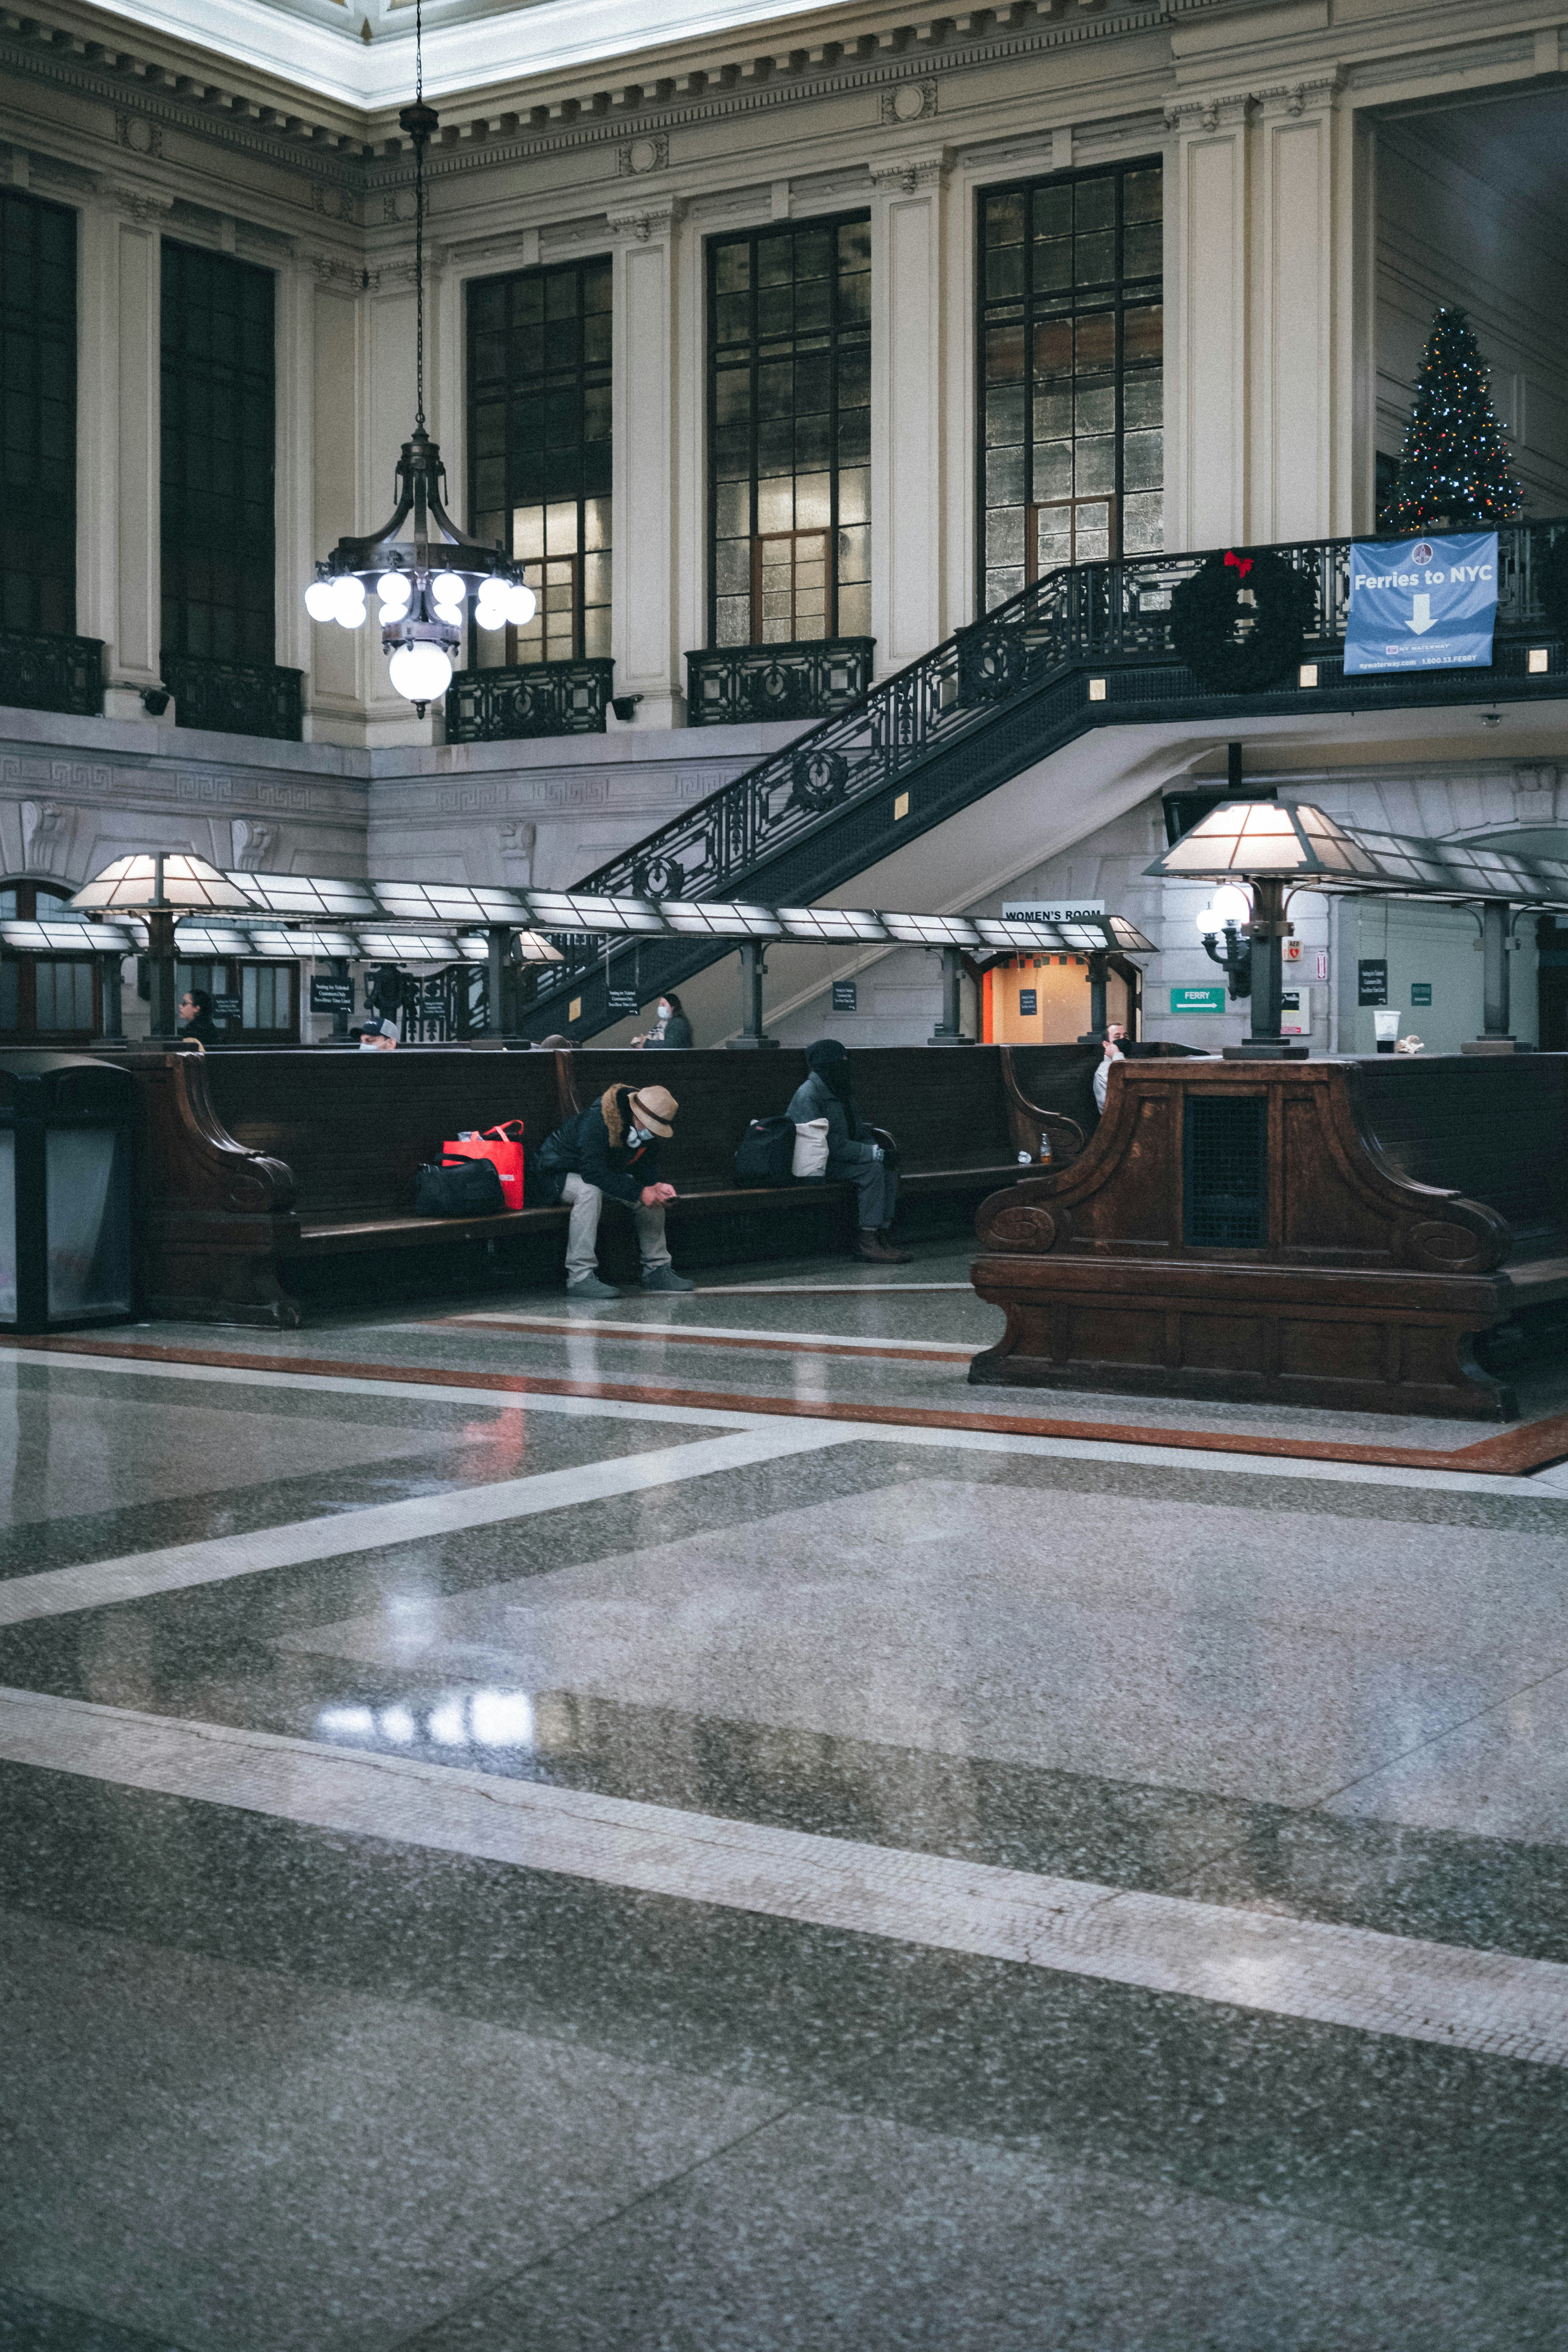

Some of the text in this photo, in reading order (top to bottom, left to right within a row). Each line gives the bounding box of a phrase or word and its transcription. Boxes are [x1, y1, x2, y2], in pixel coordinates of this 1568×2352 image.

[1355, 565, 1493, 590] Ferries to NYC
[1360, 659, 1416, 669] nywaterway.com
[1006, 911, 1061, 920] WOMEN'S
